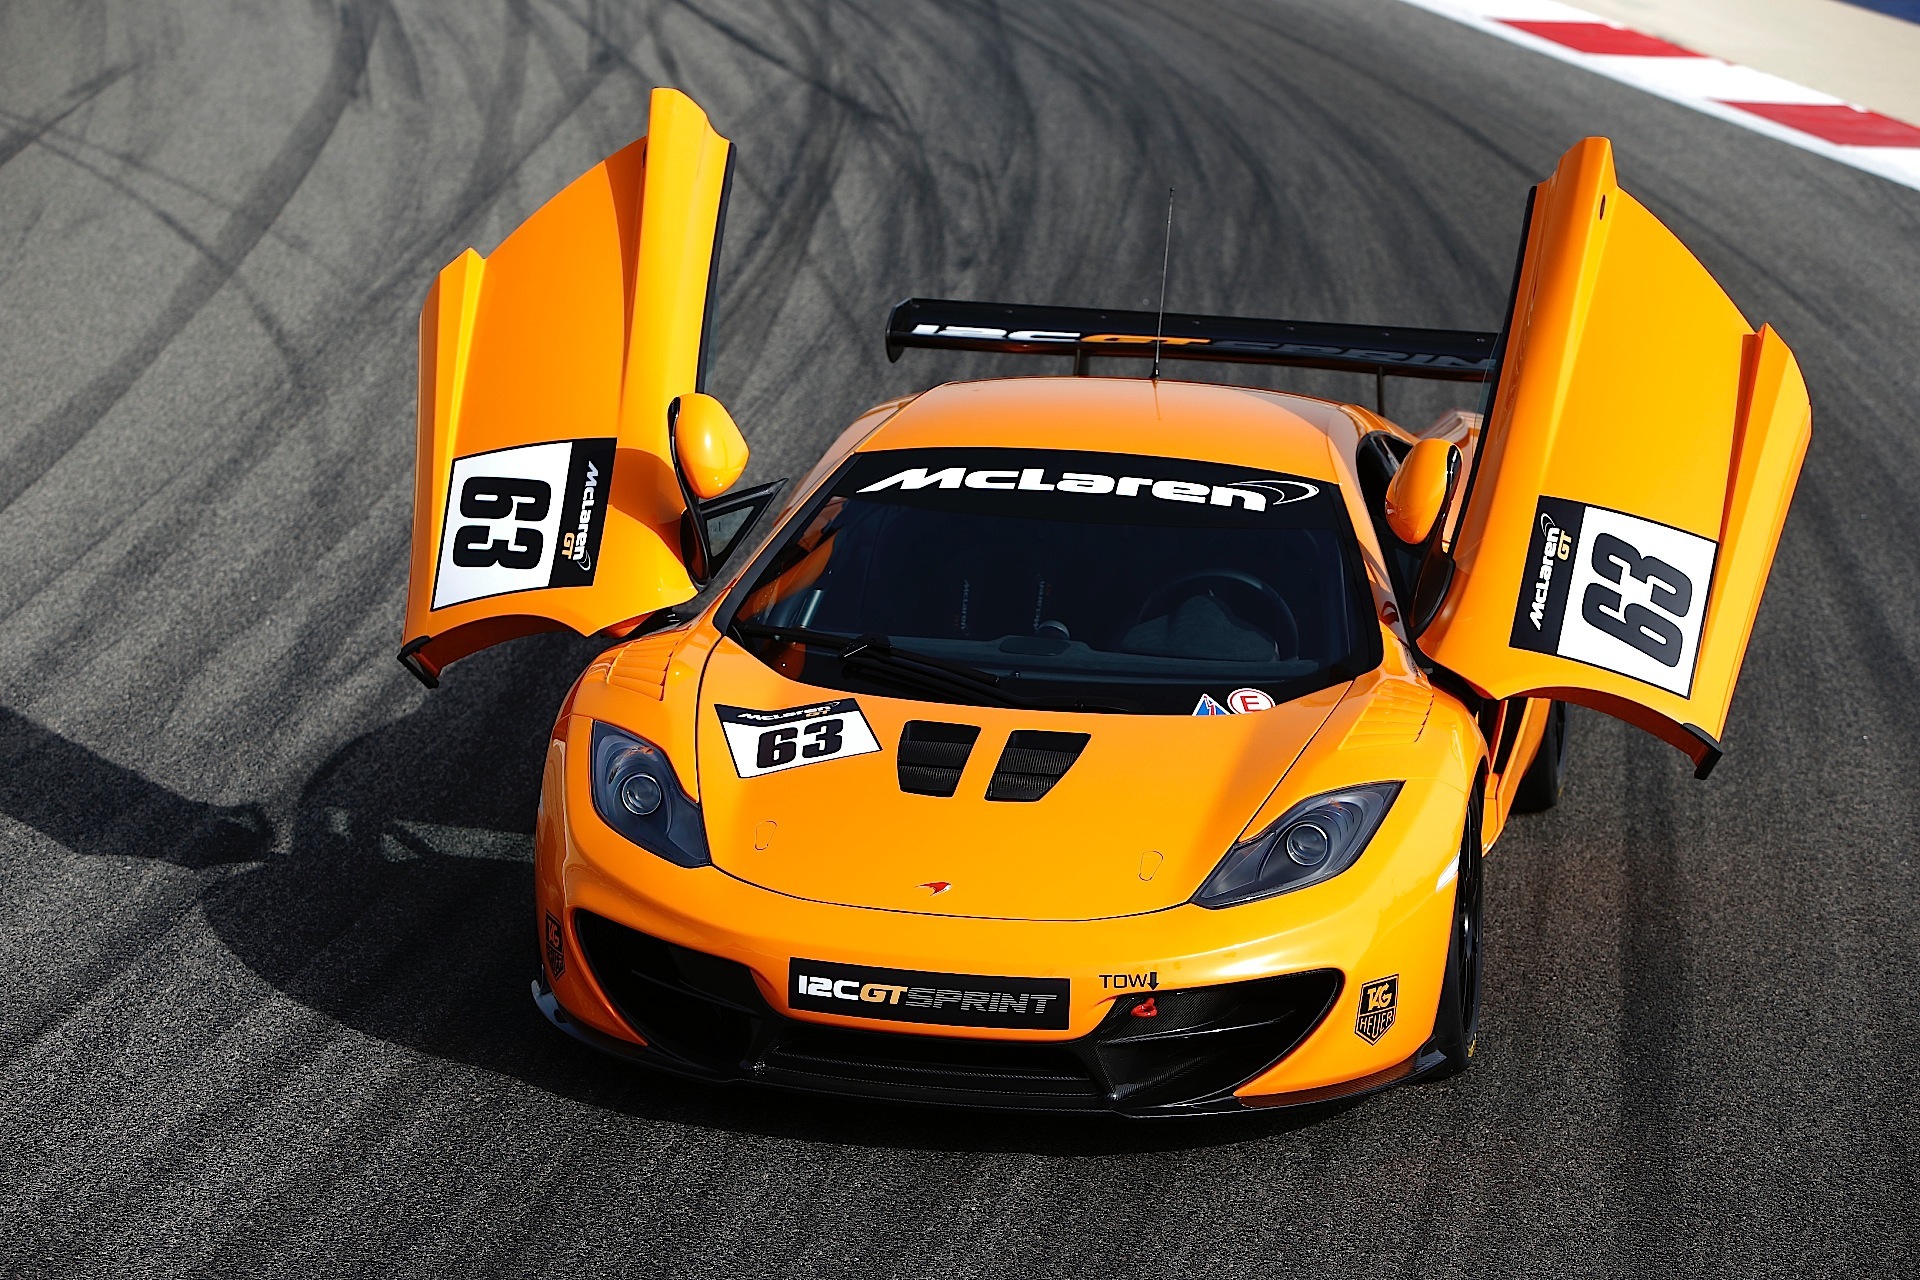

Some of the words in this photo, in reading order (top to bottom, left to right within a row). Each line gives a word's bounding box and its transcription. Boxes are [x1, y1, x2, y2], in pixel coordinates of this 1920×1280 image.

[856, 467, 1267, 512] McLaren
[452, 476, 552, 569] 63
[572, 461, 599, 561] McLaren
[561, 532, 575, 559] GT
[1557, 529, 1572, 561] GT
[1529, 527, 1560, 631] McLaren
[1581, 533, 1692, 667] 63
[737, 706, 831, 721] McLaren
[1240, 695, 1263, 712] E
[756, 718, 844, 769] 63
[1099, 974, 1148, 988] TOW
[1367, 982, 1393, 1011] TAG
[1360, 1010, 1393, 1039] HEUER
